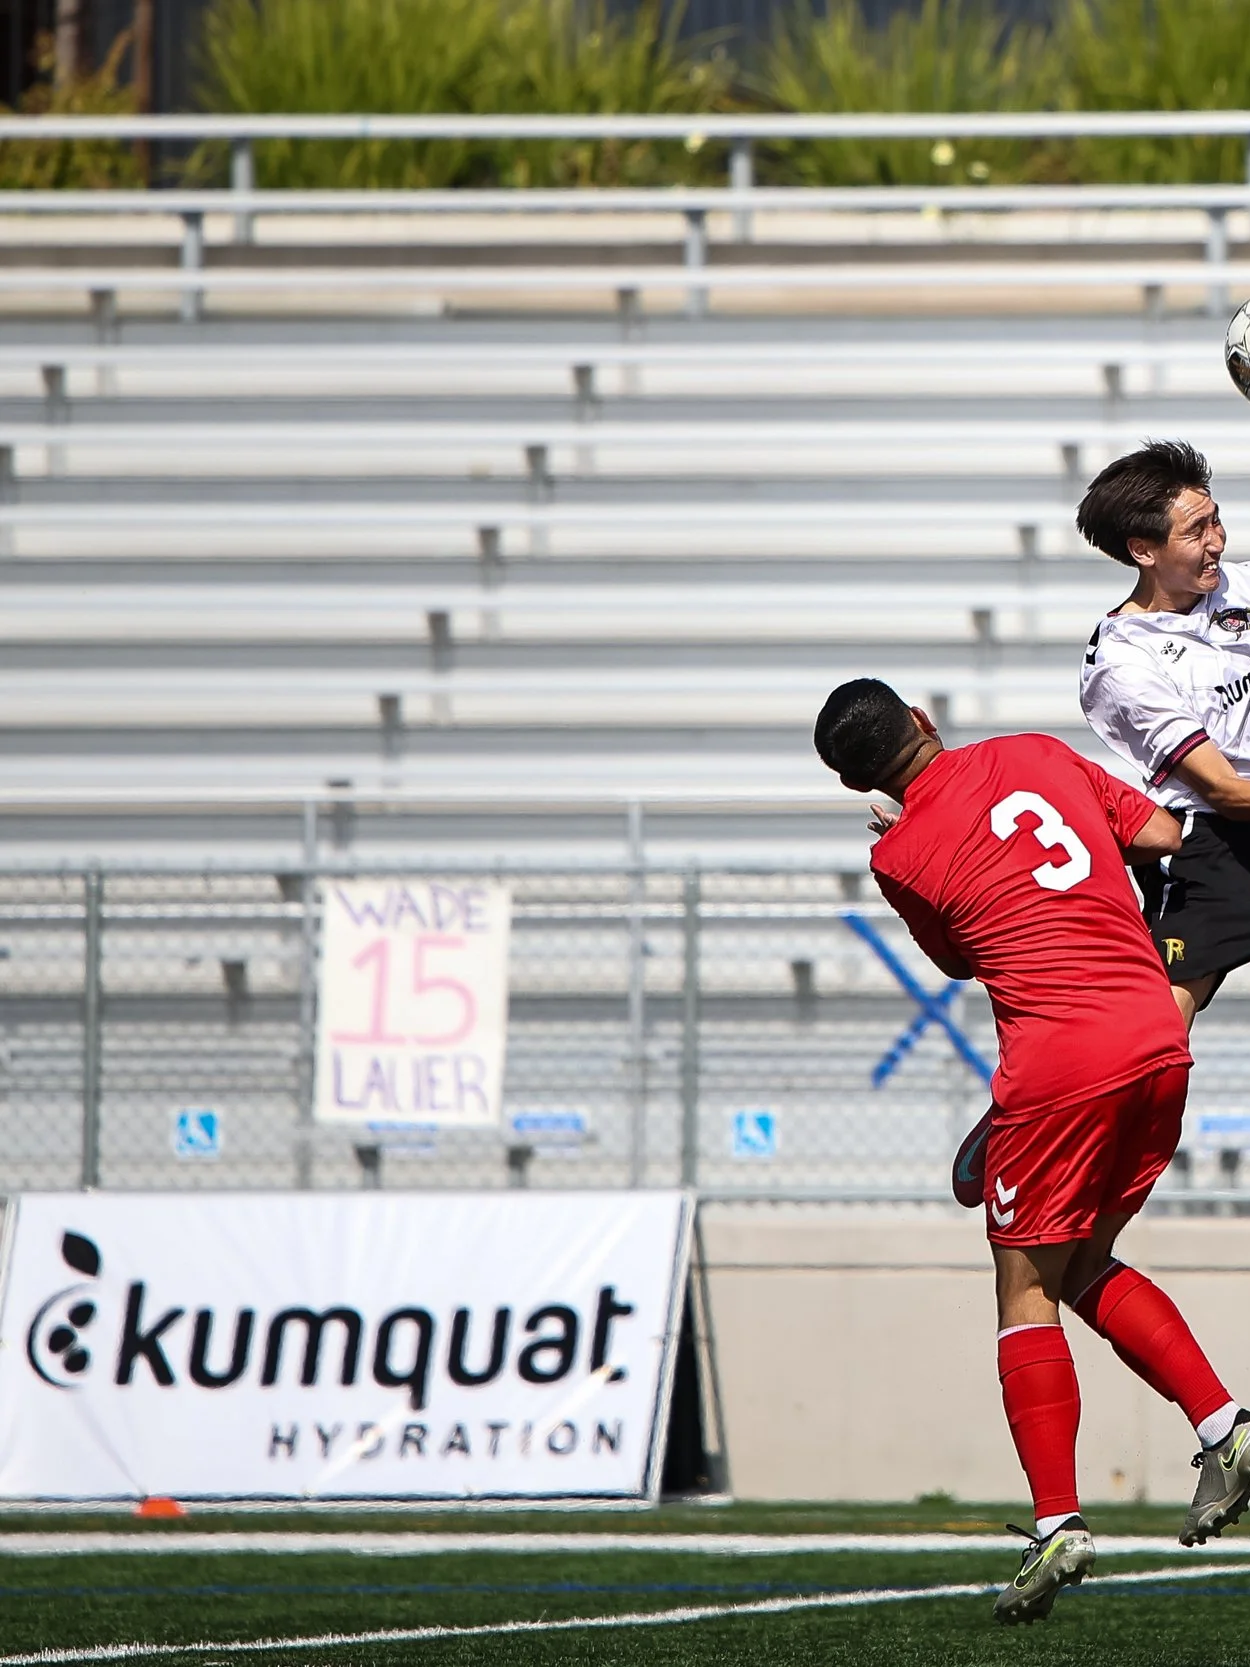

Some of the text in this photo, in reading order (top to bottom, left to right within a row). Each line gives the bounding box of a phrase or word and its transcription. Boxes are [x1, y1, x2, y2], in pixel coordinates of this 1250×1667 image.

[990, 790, 1092, 892] 3
[335, 884, 490, 932] WADE
[1162, 938, 1185, 966] R
[330, 935, 479, 1047] 15
[332, 1049, 489, 1113] LAUER
[115, 1280, 636, 1411] kumquat
[268, 1422, 623, 1459] HYDRATION
